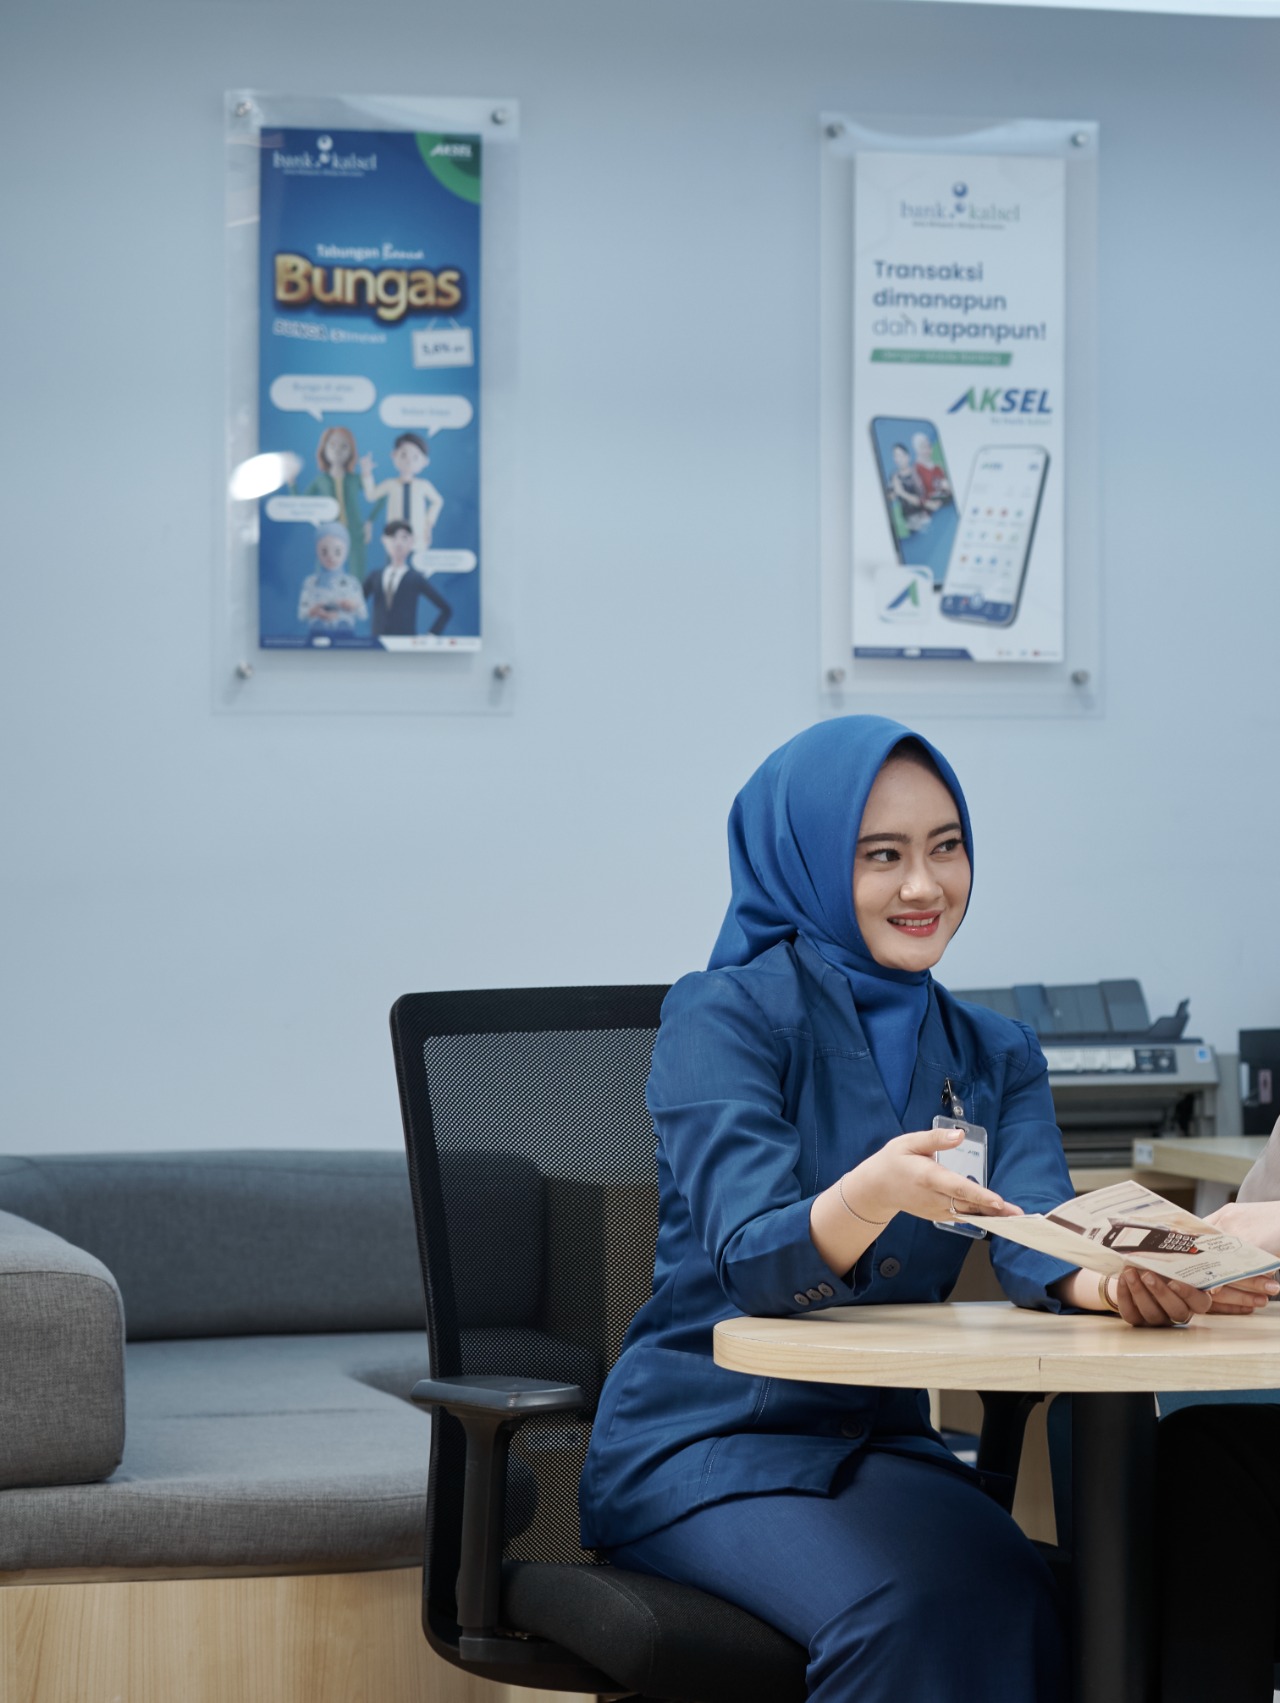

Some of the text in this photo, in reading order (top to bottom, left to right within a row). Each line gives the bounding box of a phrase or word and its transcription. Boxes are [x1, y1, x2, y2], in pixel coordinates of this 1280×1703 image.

[272, 151, 378, 171] bank kalsel
[899, 199, 1021, 223] bank kalsel
[873, 260, 985, 282] Transaksi
[274, 253, 462, 322] Bungas
[872, 288, 1008, 315] dimanapun
[872, 317, 1047, 344] dan kapanpun!
[947, 387, 1053, 415] AKSEL
